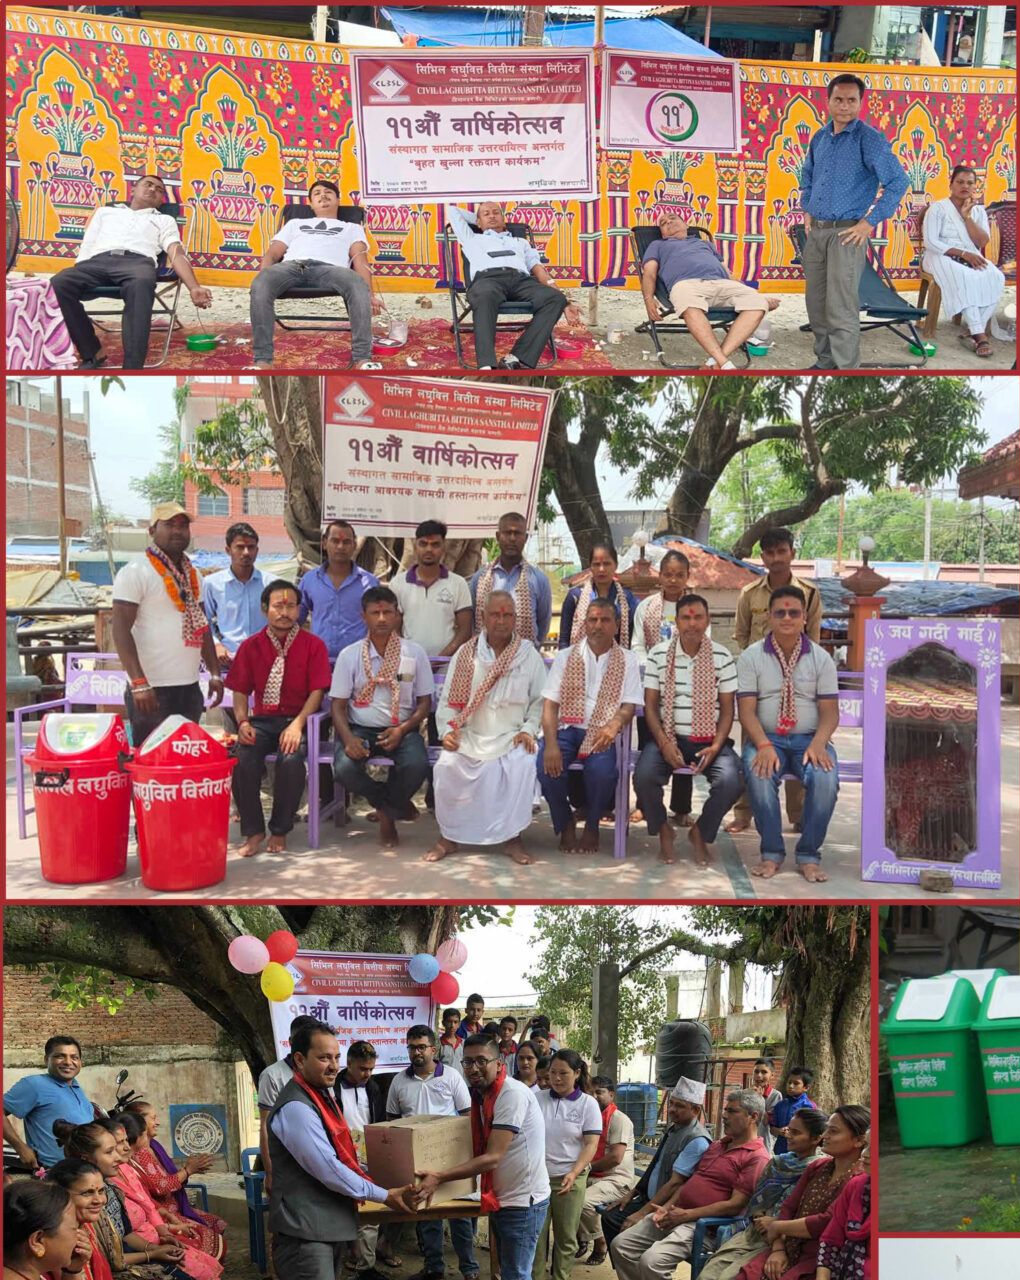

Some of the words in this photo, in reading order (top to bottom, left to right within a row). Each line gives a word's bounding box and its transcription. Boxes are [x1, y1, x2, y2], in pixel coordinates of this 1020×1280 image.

[416, 63, 446, 75] सिभिल
[451, 64, 484, 77] लघुवित्त
[488, 63, 515, 75] वित्तीय
[519, 63, 542, 74] संस्था
[547, 62, 580, 74] लिमिटेड
[417, 87, 437, 95] CIVIL
[438, 86, 486, 94] LAGHUBITTA
[488, 86, 517, 94] BITTIYA
[551, 85, 582, 93] LIMITED
[450, 111, 565, 136] वार्षिकोत्सव
[389, 144, 427, 154] संस्थागत
[432, 144, 473, 153] सामाजिक
[532, 140, 565, 151] अन्तर्गत
[383, 384, 413, 398] सिभिल
[417, 388, 449, 402] लघुवित्त
[453, 391, 480, 404] वित्तीय
[485, 395, 506, 407] संस्था
[382, 408, 401, 417] CIVIL
[412, 440, 519, 470] वार्षिकोत्सव
[889, 625, 913, 639] जय
[172, 735, 210, 757] फोहर
[182, 779, 222, 799] वित्तीय
[337, 1001, 416, 1020] वार्षिकोत्सव
